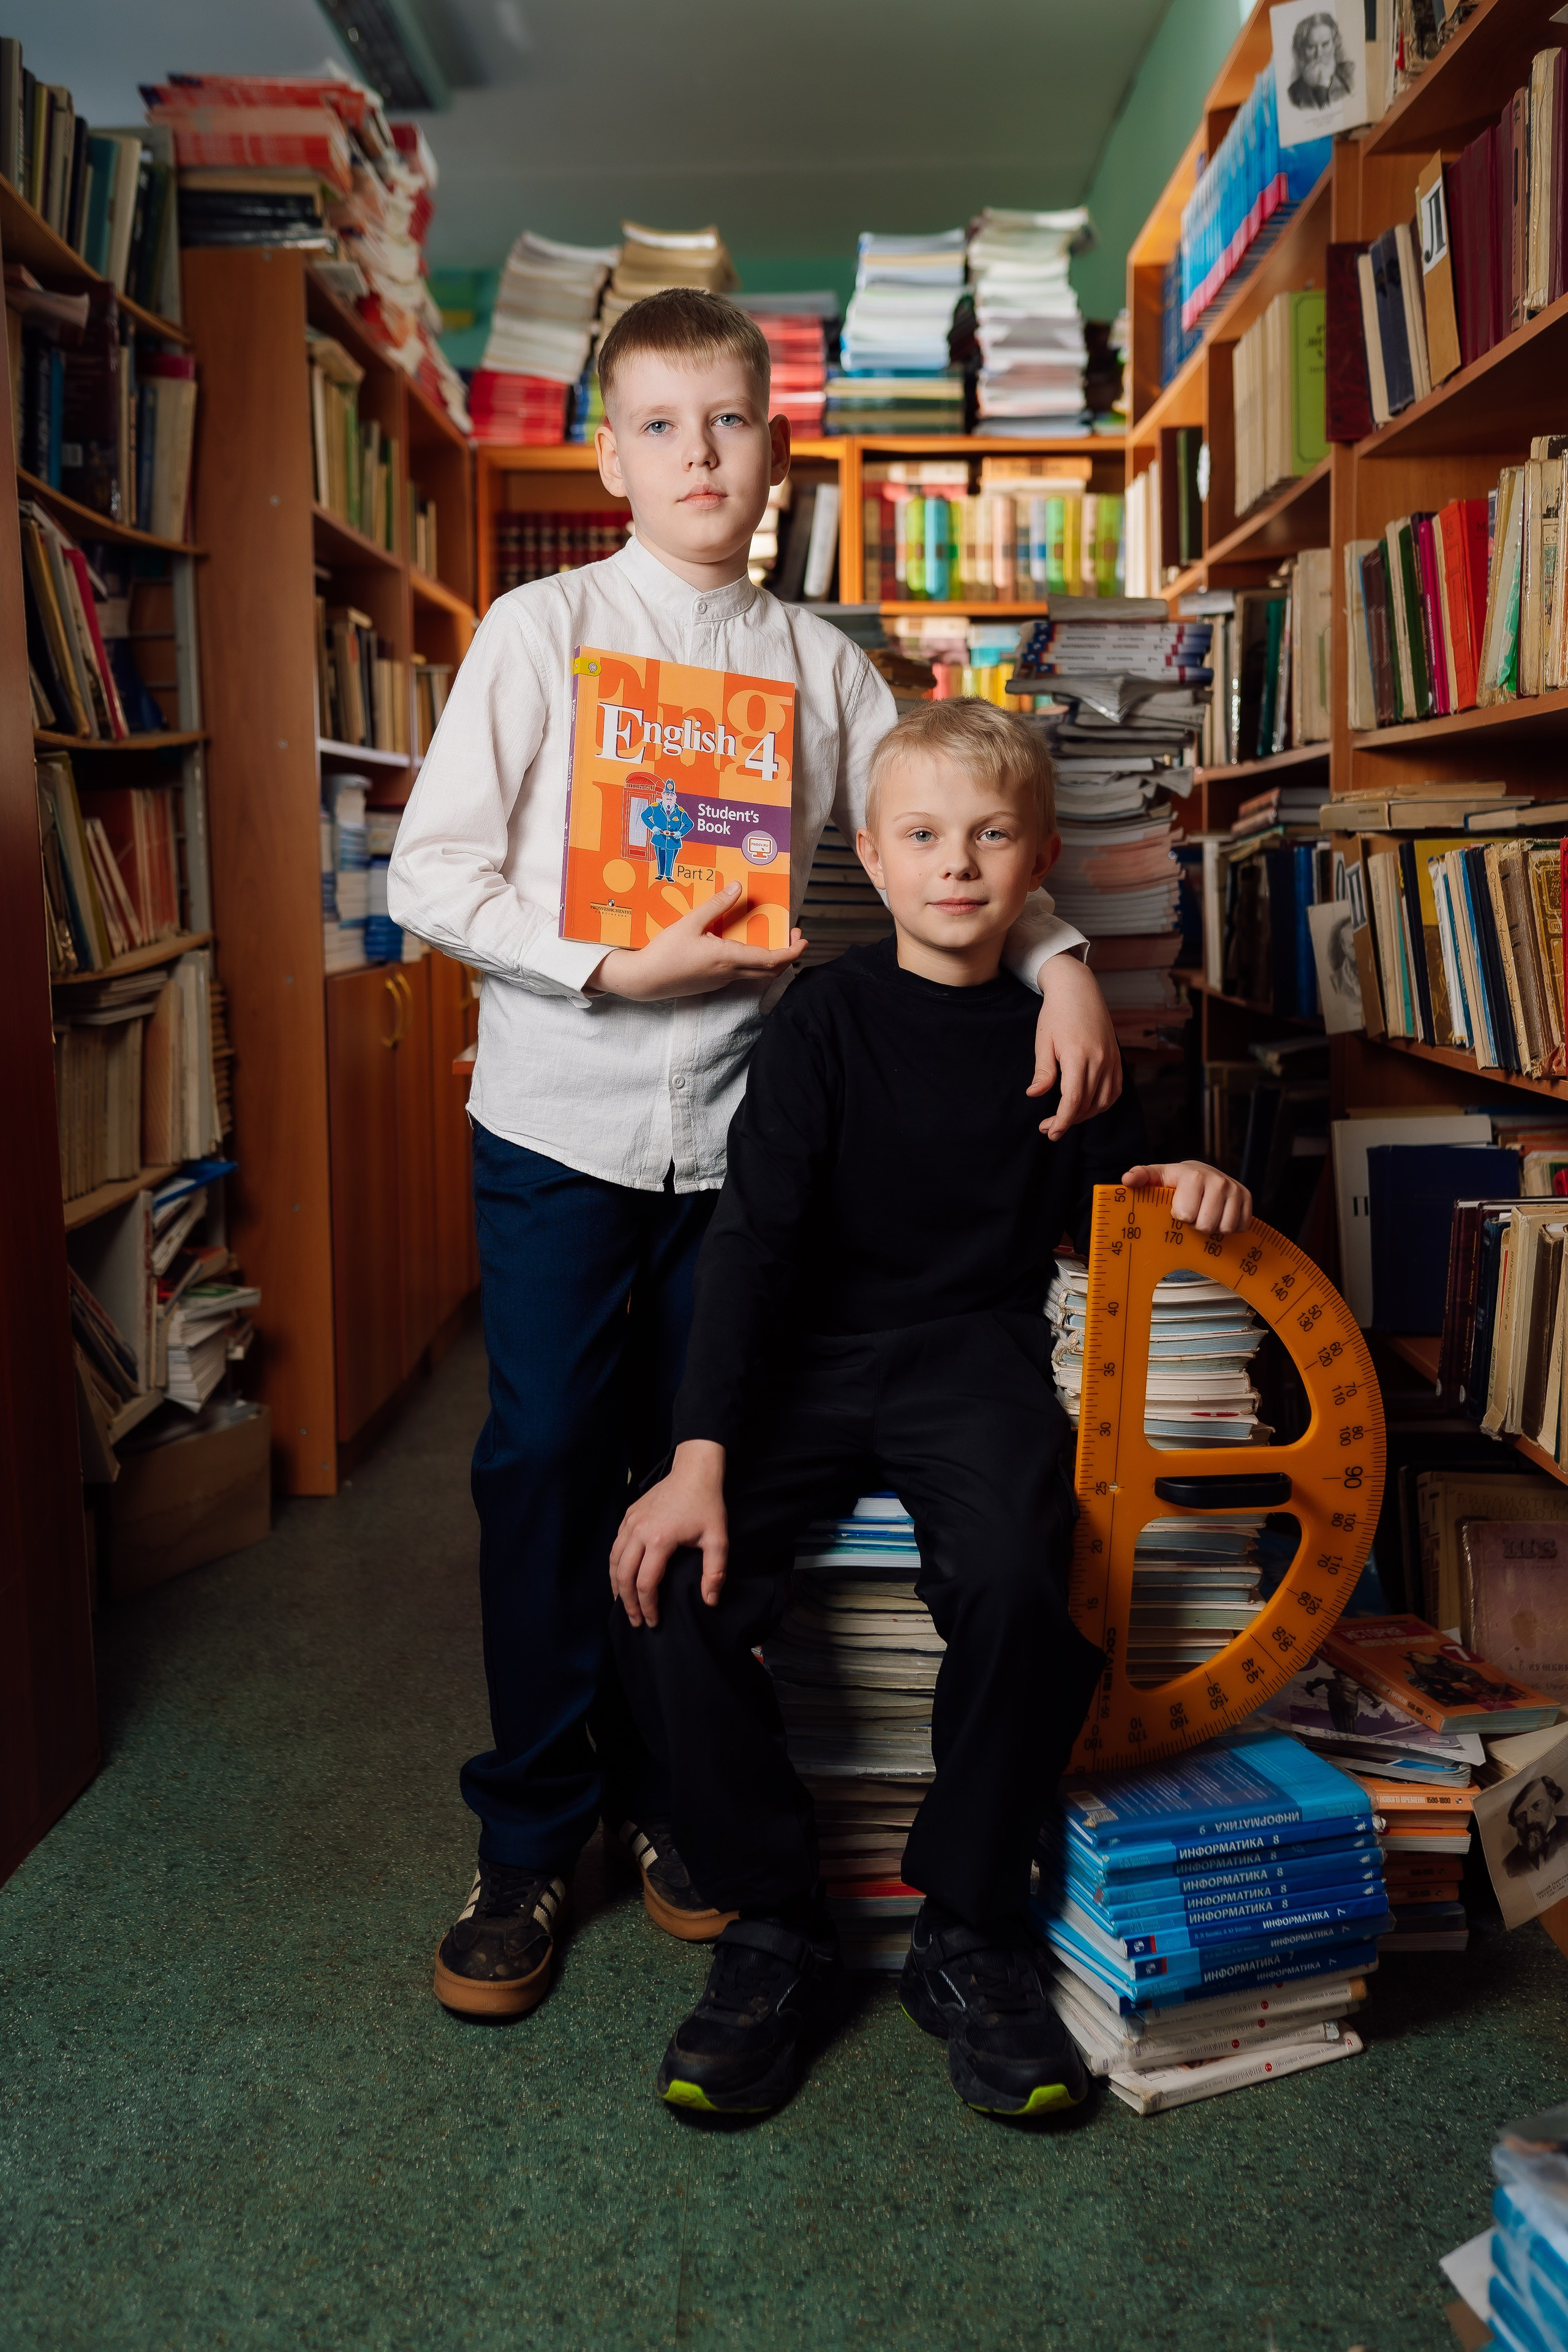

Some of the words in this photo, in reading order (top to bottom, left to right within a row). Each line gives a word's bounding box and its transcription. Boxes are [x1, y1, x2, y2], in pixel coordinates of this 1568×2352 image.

[594, 702, 737, 765] English
[745, 731, 778, 782] 4
[698, 803, 760, 823] Student's
[697, 818, 731, 835] Book
[677, 865, 703, 880] Part
[706, 869, 714, 881] 2
[1346, 865, 1367, 930] П
[590, 905, 632, 915] PROSVESHCHENIYE
[1115, 1188, 1126, 1202] 50
[1128, 1212, 1135, 1224] 0
[1121, 1226, 1141, 1239] 180
[1164, 1231, 1183, 1245] 170
[1112, 1241, 1123, 1256] 45
[1204, 1241, 1223, 1257] 160
[1247, 1246, 1262, 1262] 30
[1238, 1259, 1257, 1276] 150
[1281, 1273, 1295, 1288] 40
[1270, 1283, 1288, 1301] 140
[1108, 1302, 1119, 1316] 40
[1308, 1304, 1322, 1320] 50
[1296, 1312, 1313, 1332] 130
[1317, 1346, 1333, 1367] 120
[1330, 1341, 1343, 1357] 60
[1103, 1362, 1115, 1377] 35
[1332, 1385, 1346, 1406] 110
[1344, 1381, 1357, 1397] 70
[1099, 1422, 1111, 1436] 30
[1340, 1425, 1351, 1446] 100
[1352, 1425, 1363, 1440] 80
[1343, 1466, 1363, 1489] 90
[1095, 1480, 1107, 1496] 25
[1331, 1512, 1344, 1527] 80
[1343, 1512, 1357, 1532] 100
[1091, 1539, 1102, 1554] 20
[1317, 1553, 1331, 1568] 70
[1328, 1555, 1343, 1575] 110
[1087, 1597, 1099, 1611] 15
[1297, 1591, 1311, 1606] 60
[1305, 1596, 1323, 1615] 120
[1272, 1626, 1287, 1642] 50
[1278, 1632, 1296, 1652] 130
[1443, 1645, 1470, 1661] 7
[1241, 1657, 1254, 1672] 40
[1246, 1665, 1265, 1684] 140
[1207, 1682, 1222, 1698] 30
[1101, 1694, 1110, 1719] K-50
[1170, 1702, 1184, 1716] 20
[1210, 1693, 1229, 1710] 150
[1092, 1724, 1099, 1736] 0
[1130, 1717, 1143, 1730] 10
[1170, 1714, 1189, 1730] 160
[1128, 1728, 1148, 1743] 170
[1084, 1738, 1102, 1751] 180
[1215, 1811, 1300, 1833] ИНФОРМАТИКА
[1179, 1837, 1264, 1860] ИНФОРМАТИКА
[1272, 1834, 1280, 1845] 8
[1176, 1853, 1261, 1875] ИНФОРМАТИКА
[1270, 1851, 1277, 1861] 8
[1183, 1868, 1268, 1892] ИНФОРМАТИКА
[1276, 1867, 1284, 1877] 8
[1187, 1887, 1272, 1909] ИНФОРМАТИКА
[1280, 1884, 1287, 1894] 8
[1189, 1902, 1273, 1925] ИНФОРМАТИКА
[1281, 1899, 1288, 1909] 8
[1262, 1910, 1330, 1930] ИНФОРМАТИКА
[1336, 1907, 1346, 1917] 7
[1270, 1928, 1334, 1948] ИНФОРМАТИКА
[1341, 1925, 1351, 1934] 7
[1204, 1954, 1281, 1983] ИНФОРМАТИКА
[1288, 1950, 1295, 1961] 7
[1257, 1961, 1321, 1981] ИНФОРМАТИКА
[1329, 1958, 1338, 1966] 7
[1216, 2003, 1258, 2018] ГЕОГРАФИЯ
[1215, 2022, 1256, 2037] ГЕОГРАФИЯ
[1186, 2041, 1228, 2055] ГЕОГРАФИЯ
[1225, 2066, 1263, 2084] ГЕОГРАФИЯ
